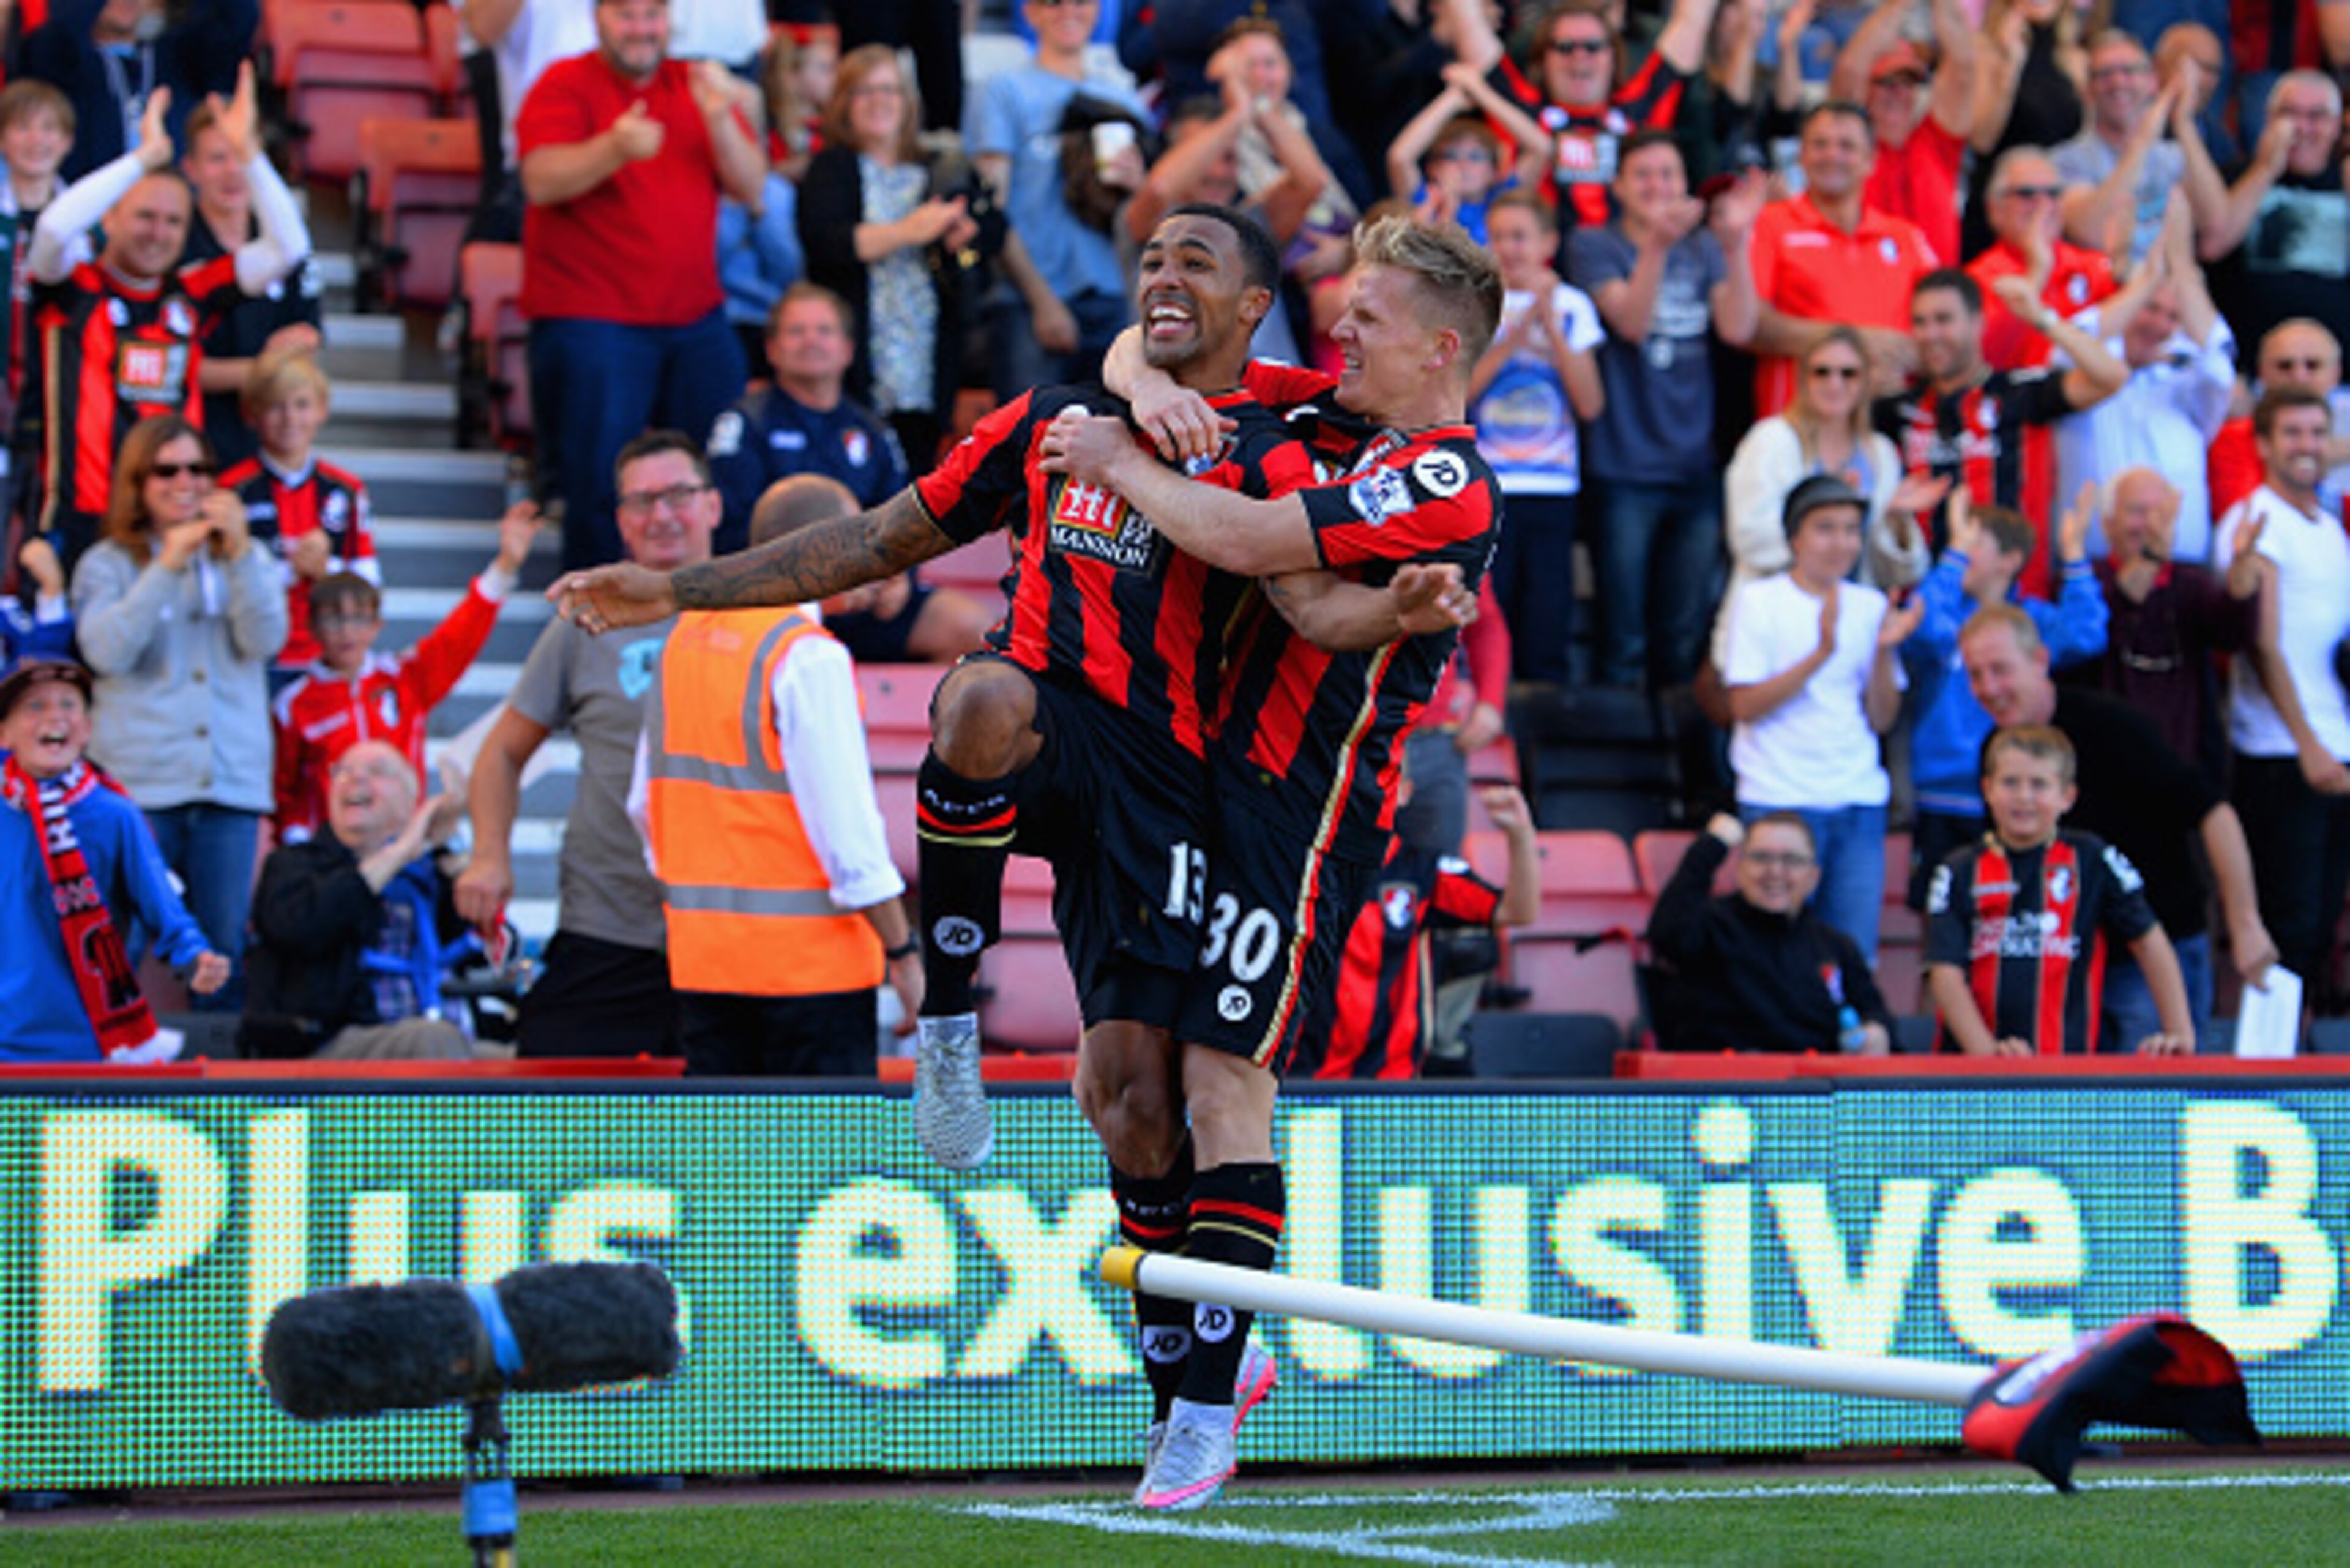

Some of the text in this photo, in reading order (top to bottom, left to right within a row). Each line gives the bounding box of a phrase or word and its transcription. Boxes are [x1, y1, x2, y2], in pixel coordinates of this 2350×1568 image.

[1051, 525, 1150, 569] MANSION
[1198, 892, 1280, 982] 30
[797, 1100, 2086, 1391] exlusive
